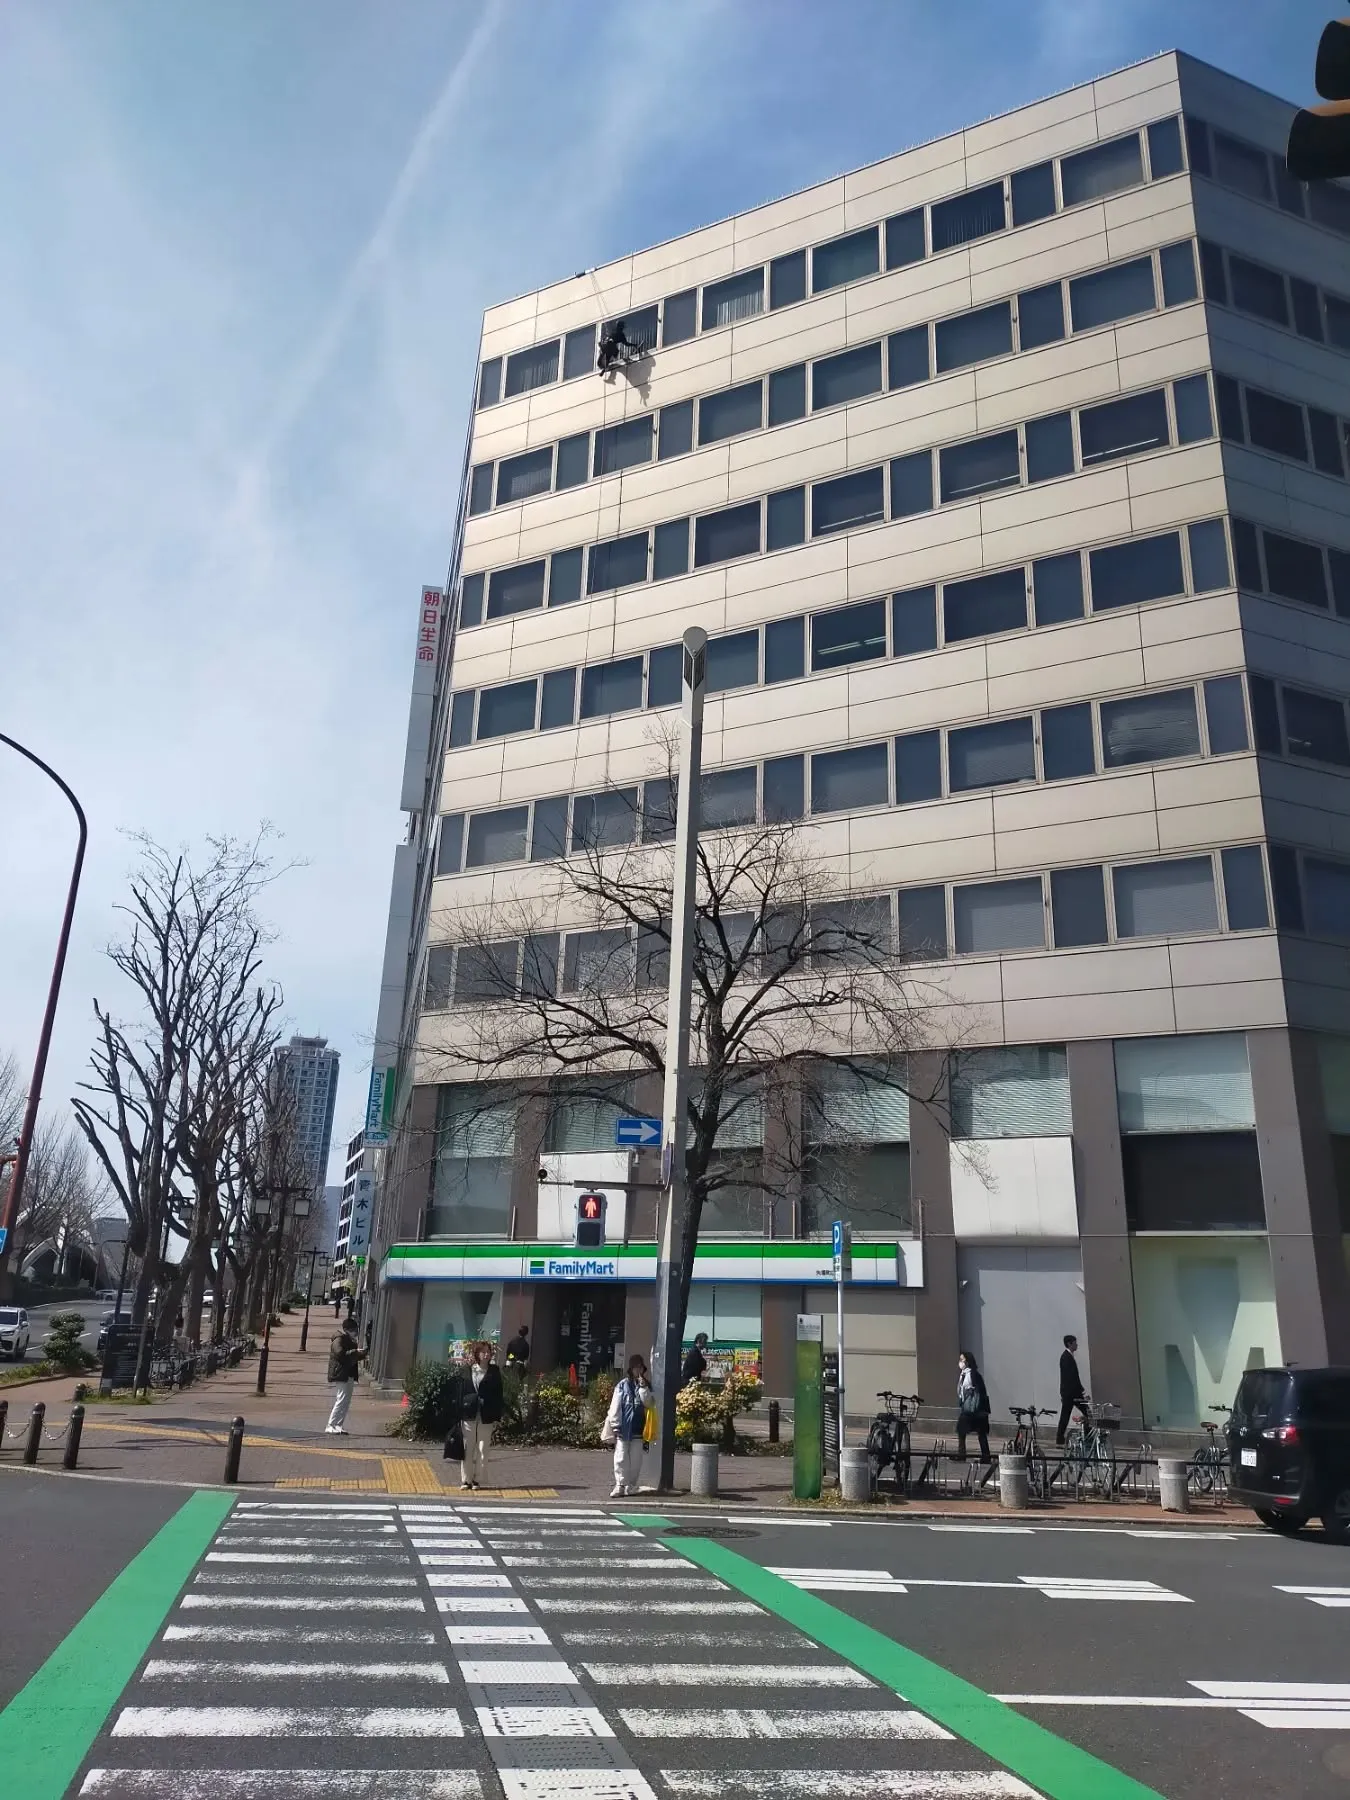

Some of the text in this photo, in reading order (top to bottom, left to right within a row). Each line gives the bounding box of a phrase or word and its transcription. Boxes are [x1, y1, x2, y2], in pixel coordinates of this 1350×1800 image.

[418, 591, 440, 661] 朝日生命
[370, 1072, 384, 1127] FamilyMart
[549, 1261, 614, 1275] FamilyMart
